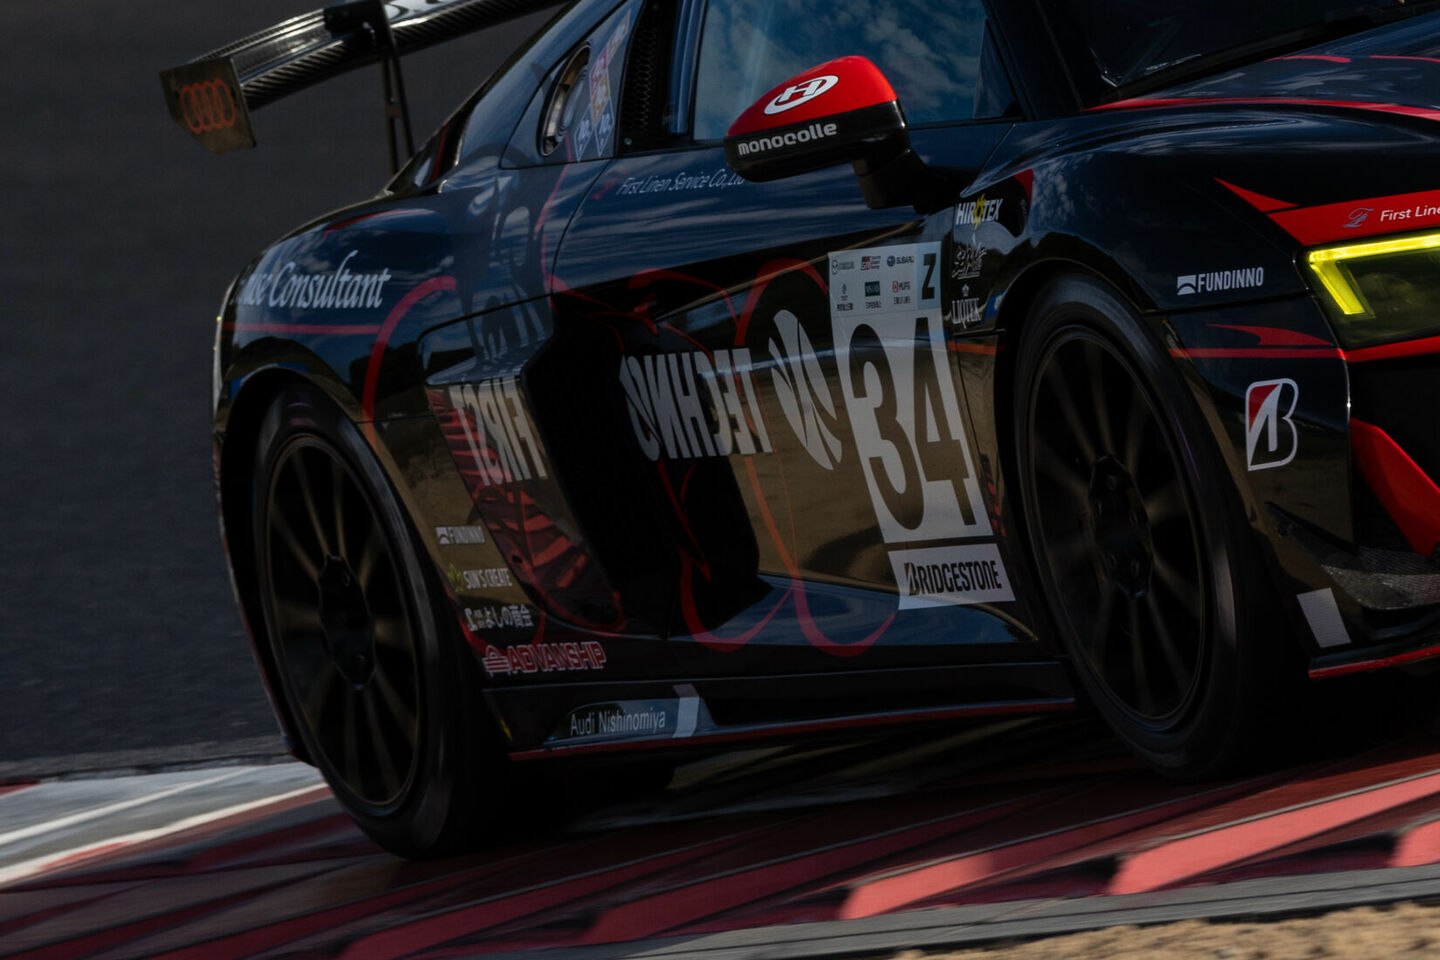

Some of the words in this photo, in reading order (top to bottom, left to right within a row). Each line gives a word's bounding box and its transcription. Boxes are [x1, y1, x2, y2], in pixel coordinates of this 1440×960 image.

[738, 123, 838, 156] monocolle
[616, 177, 643, 195] First
[640, 175, 672, 193] Linen
[669, 171, 711, 191] Service
[1380, 209, 1412, 222] First
[268, 249, 391, 309] Consultant
[922, 253, 937, 300] Z
[1197, 266, 1264, 293] FUNDINNO
[849, 317, 977, 531] 34
[904, 559, 1002, 596] BRIDGESTONE
[506, 640, 608, 674] ADVANSHIP
[570, 711, 596, 736] Audi
[599, 707, 666, 734] Nishinomiya
